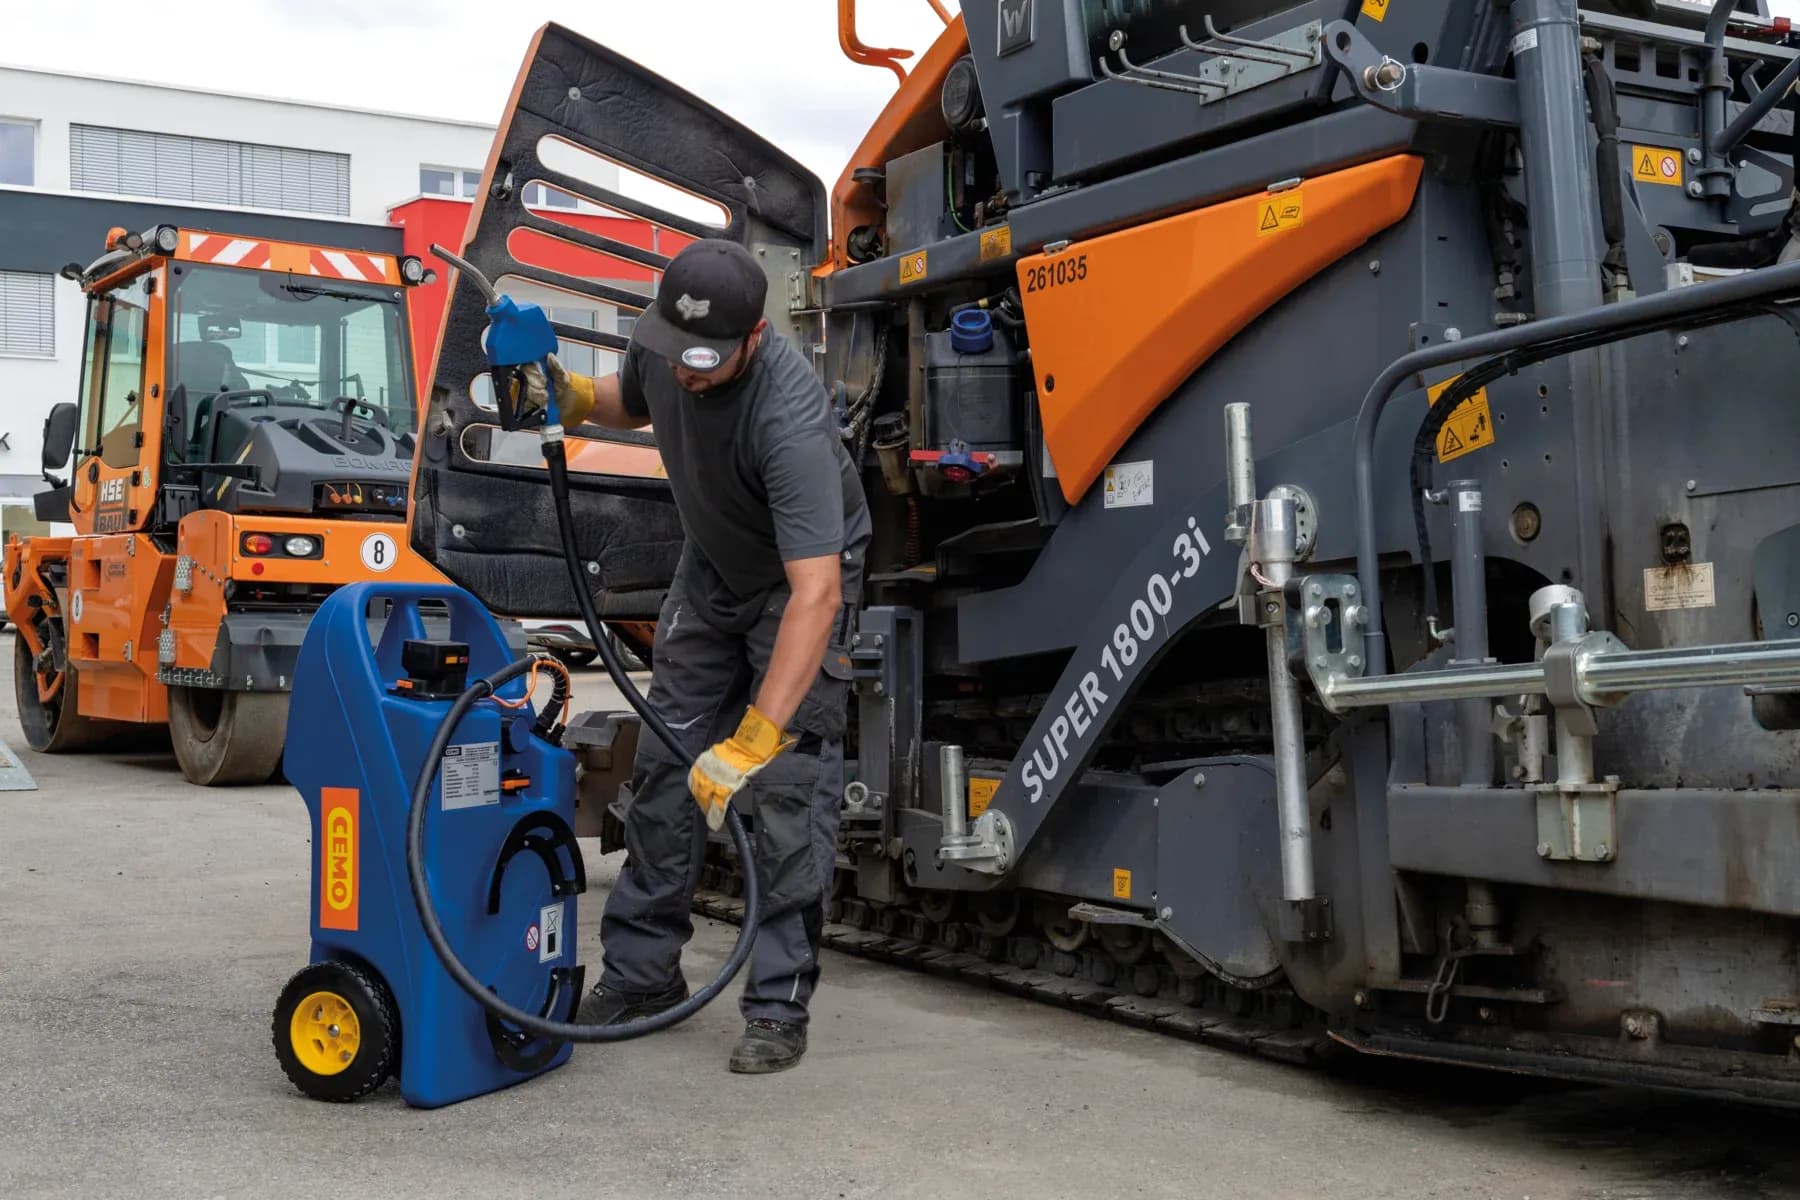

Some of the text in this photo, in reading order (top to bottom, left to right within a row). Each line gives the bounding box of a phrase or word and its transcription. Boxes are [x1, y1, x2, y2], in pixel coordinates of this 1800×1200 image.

[1027, 256, 1087, 293] 261035
[101, 478, 124, 502] HSE
[100, 514, 122, 532] BAU
[373, 540, 385, 565] 8
[1021, 516, 1212, 804] SUPER 1800-3i
[332, 815, 348, 904] CEMO
